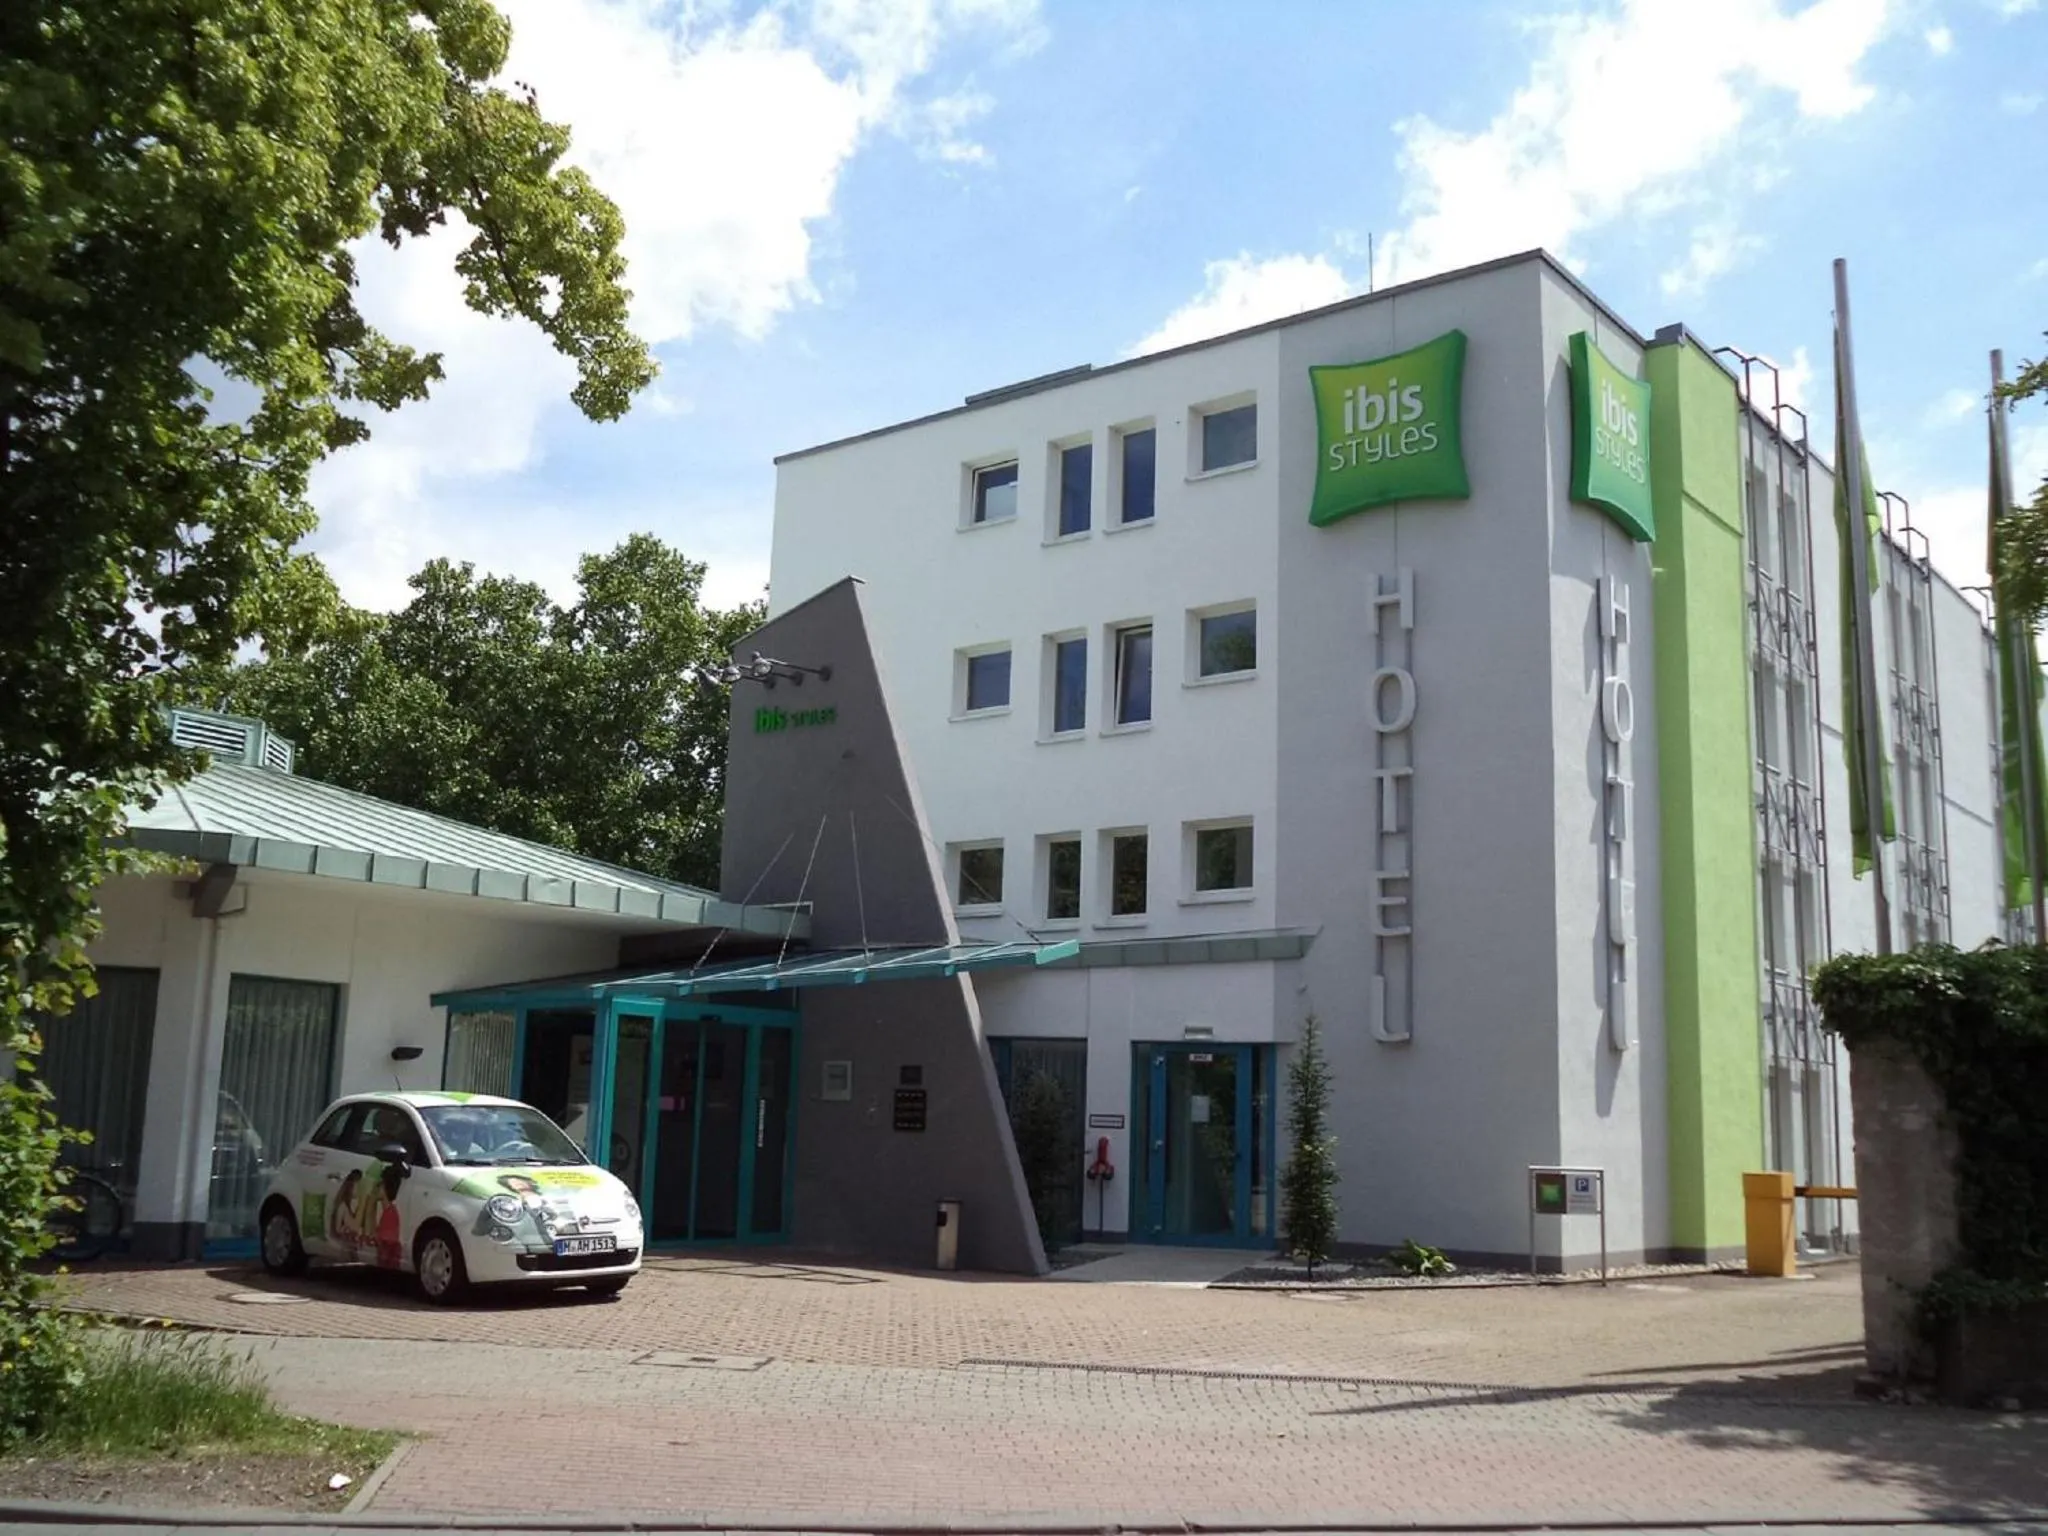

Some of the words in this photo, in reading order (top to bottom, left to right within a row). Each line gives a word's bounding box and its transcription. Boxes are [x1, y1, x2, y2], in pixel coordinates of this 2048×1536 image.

[1344, 377, 1423, 434] ibis
[1602, 379, 1638, 446] ibis
[1369, 566, 1417, 1044] HOTEL
[1600, 573, 1638, 1050] HOTEL
